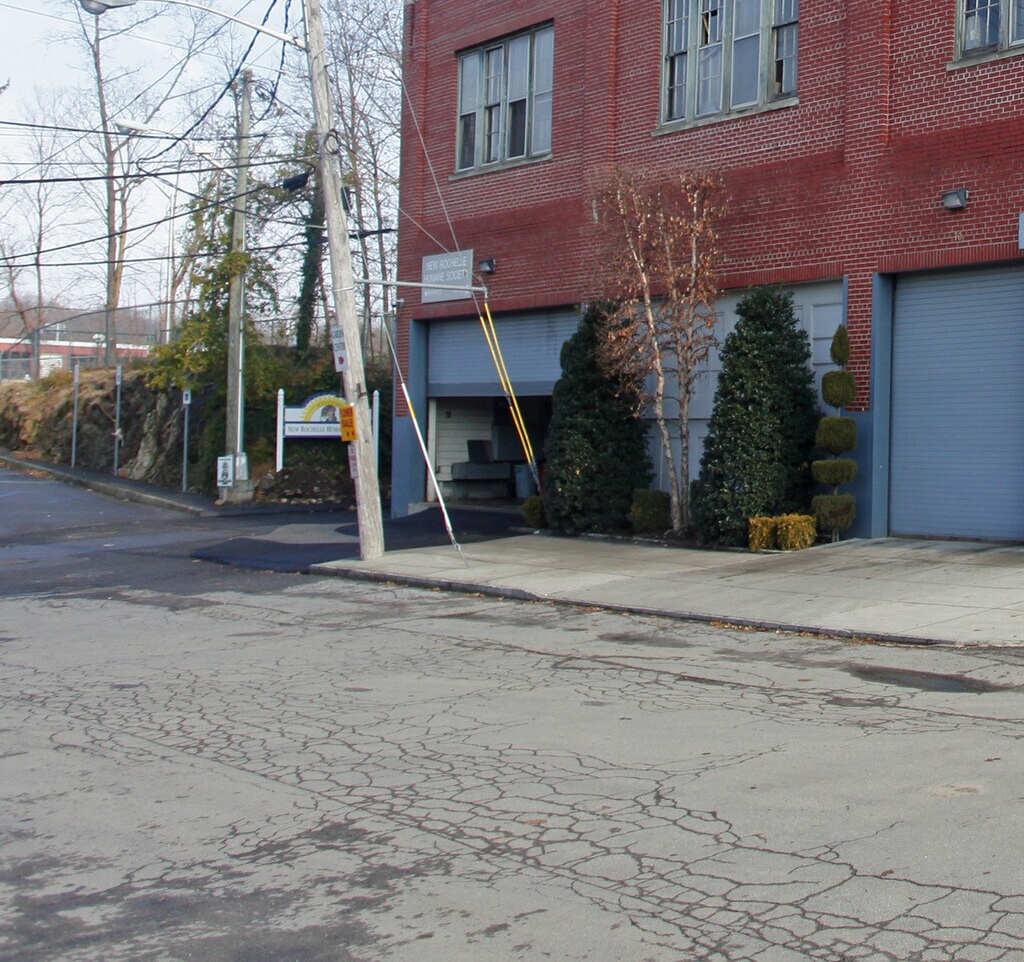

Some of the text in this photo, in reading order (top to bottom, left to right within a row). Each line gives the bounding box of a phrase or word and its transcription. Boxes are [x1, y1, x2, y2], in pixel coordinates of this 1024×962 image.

[426, 256, 467, 270] NEW ROCHELLE
[425, 272, 445, 282] HUMANE
